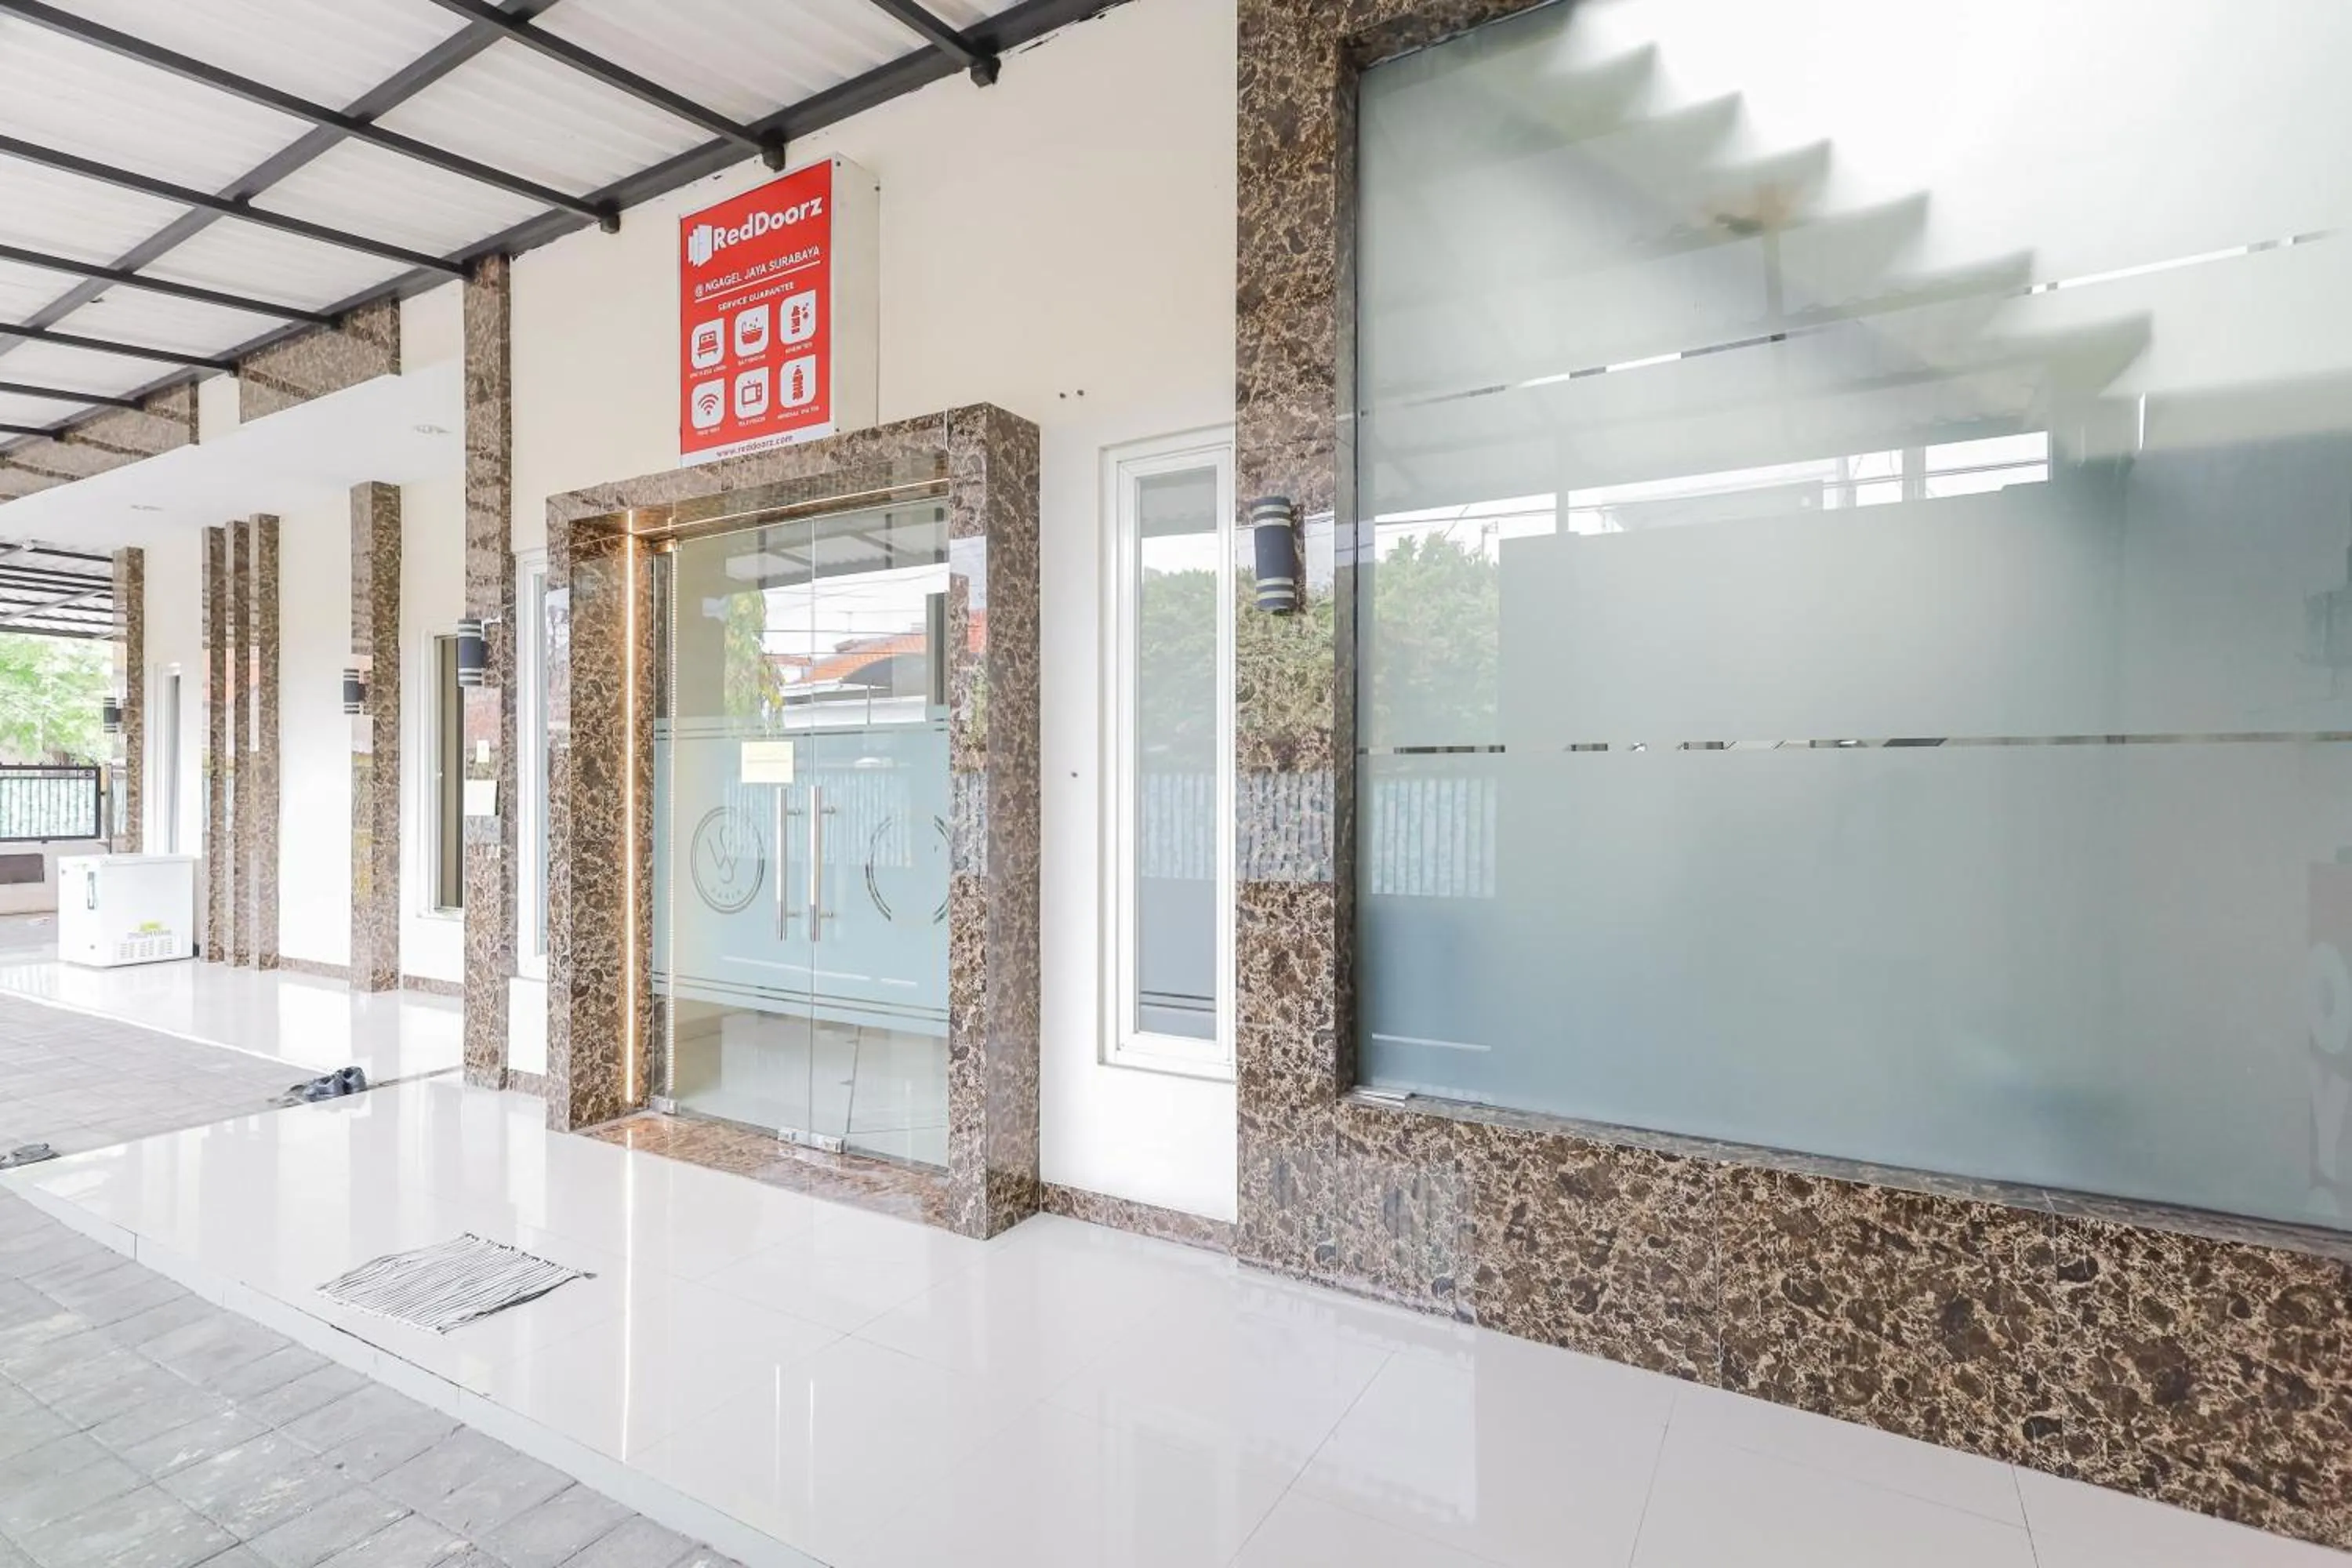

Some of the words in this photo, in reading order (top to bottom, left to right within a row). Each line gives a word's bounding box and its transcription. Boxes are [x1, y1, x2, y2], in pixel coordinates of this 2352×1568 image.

[713, 197, 822, 252] RedDoorz
[705, 271, 742, 292] NGAGEL
[744, 263, 767, 281] JAYA
[768, 245, 820, 272] SURABAYA
[717, 295, 746, 312] SERVICE
[716, 434, 793, 458] www.reddoorz.com
